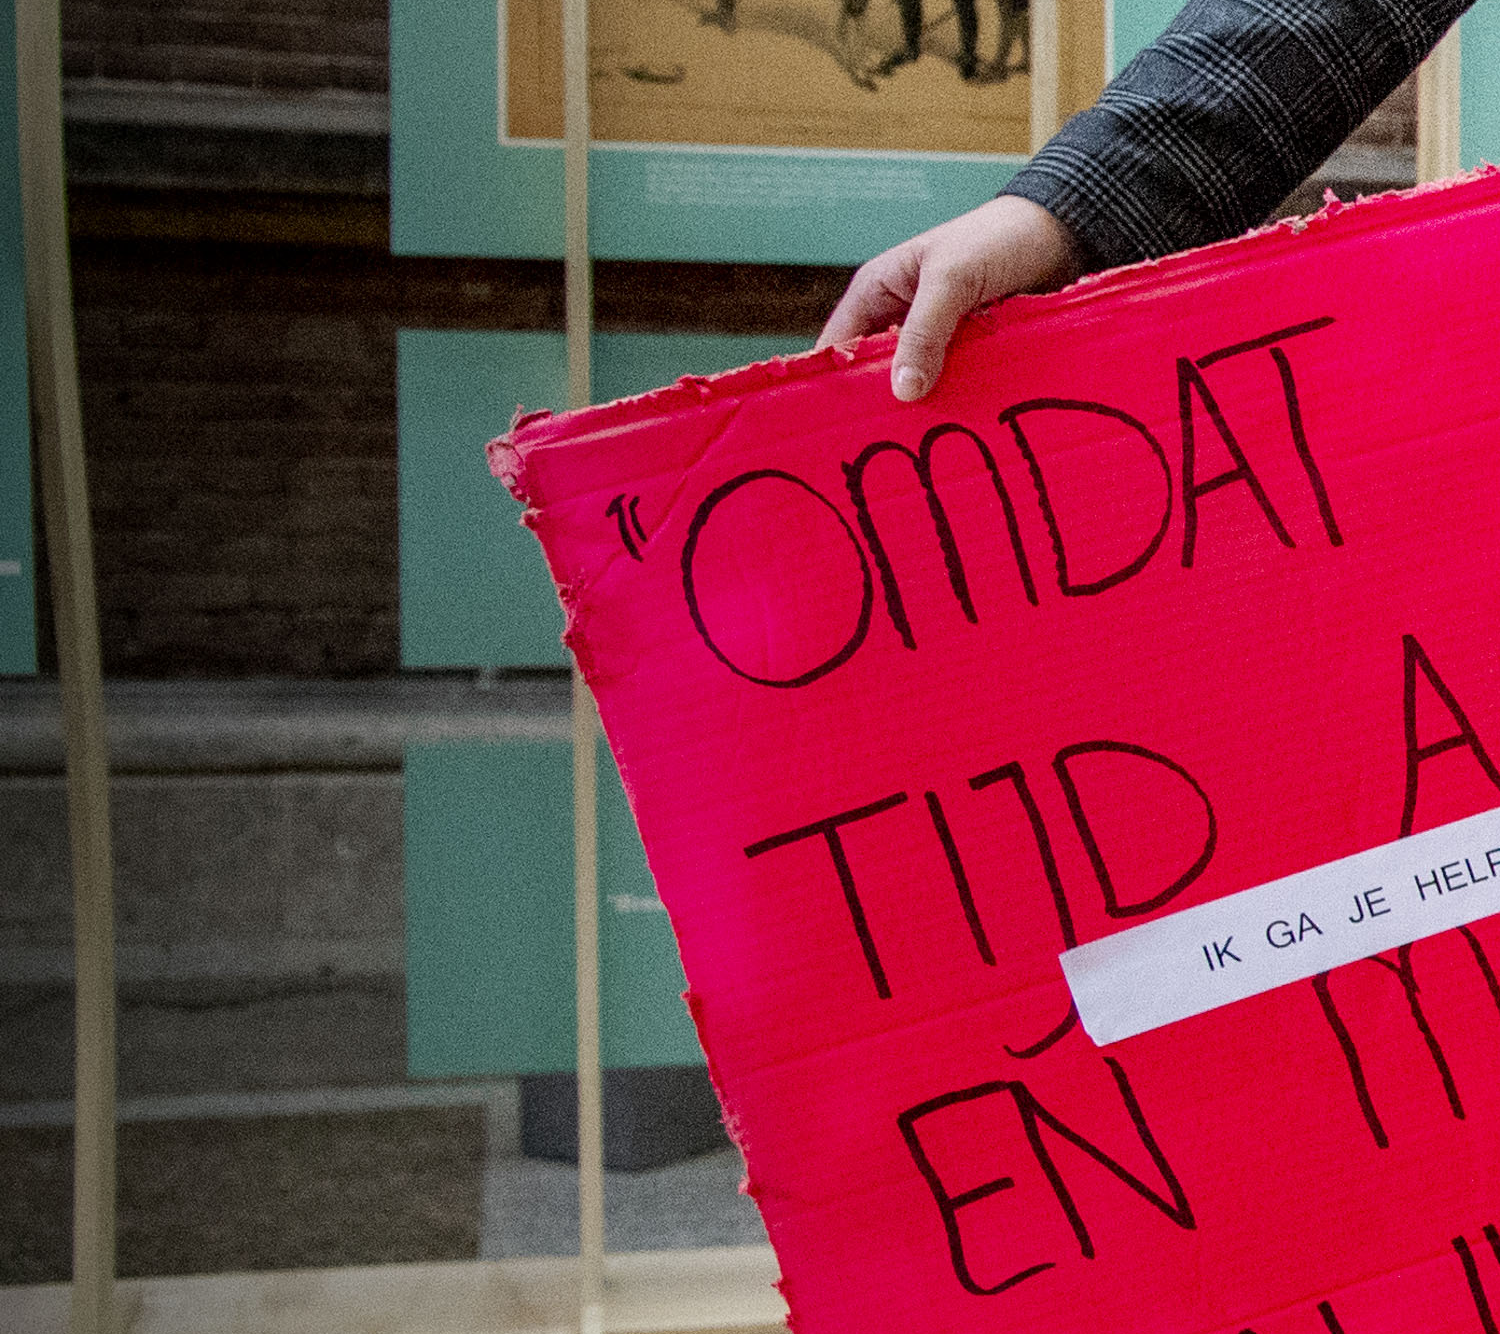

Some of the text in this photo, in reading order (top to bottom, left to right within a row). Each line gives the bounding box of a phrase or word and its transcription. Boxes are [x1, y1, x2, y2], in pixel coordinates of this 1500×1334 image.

[743, 739, 1217, 1061] TIJD
[1201, 935, 1243, 972] IK
[1265, 911, 1324, 950] GA
[1348, 886, 1392, 925] JE
[897, 1057, 1198, 1296] EN
